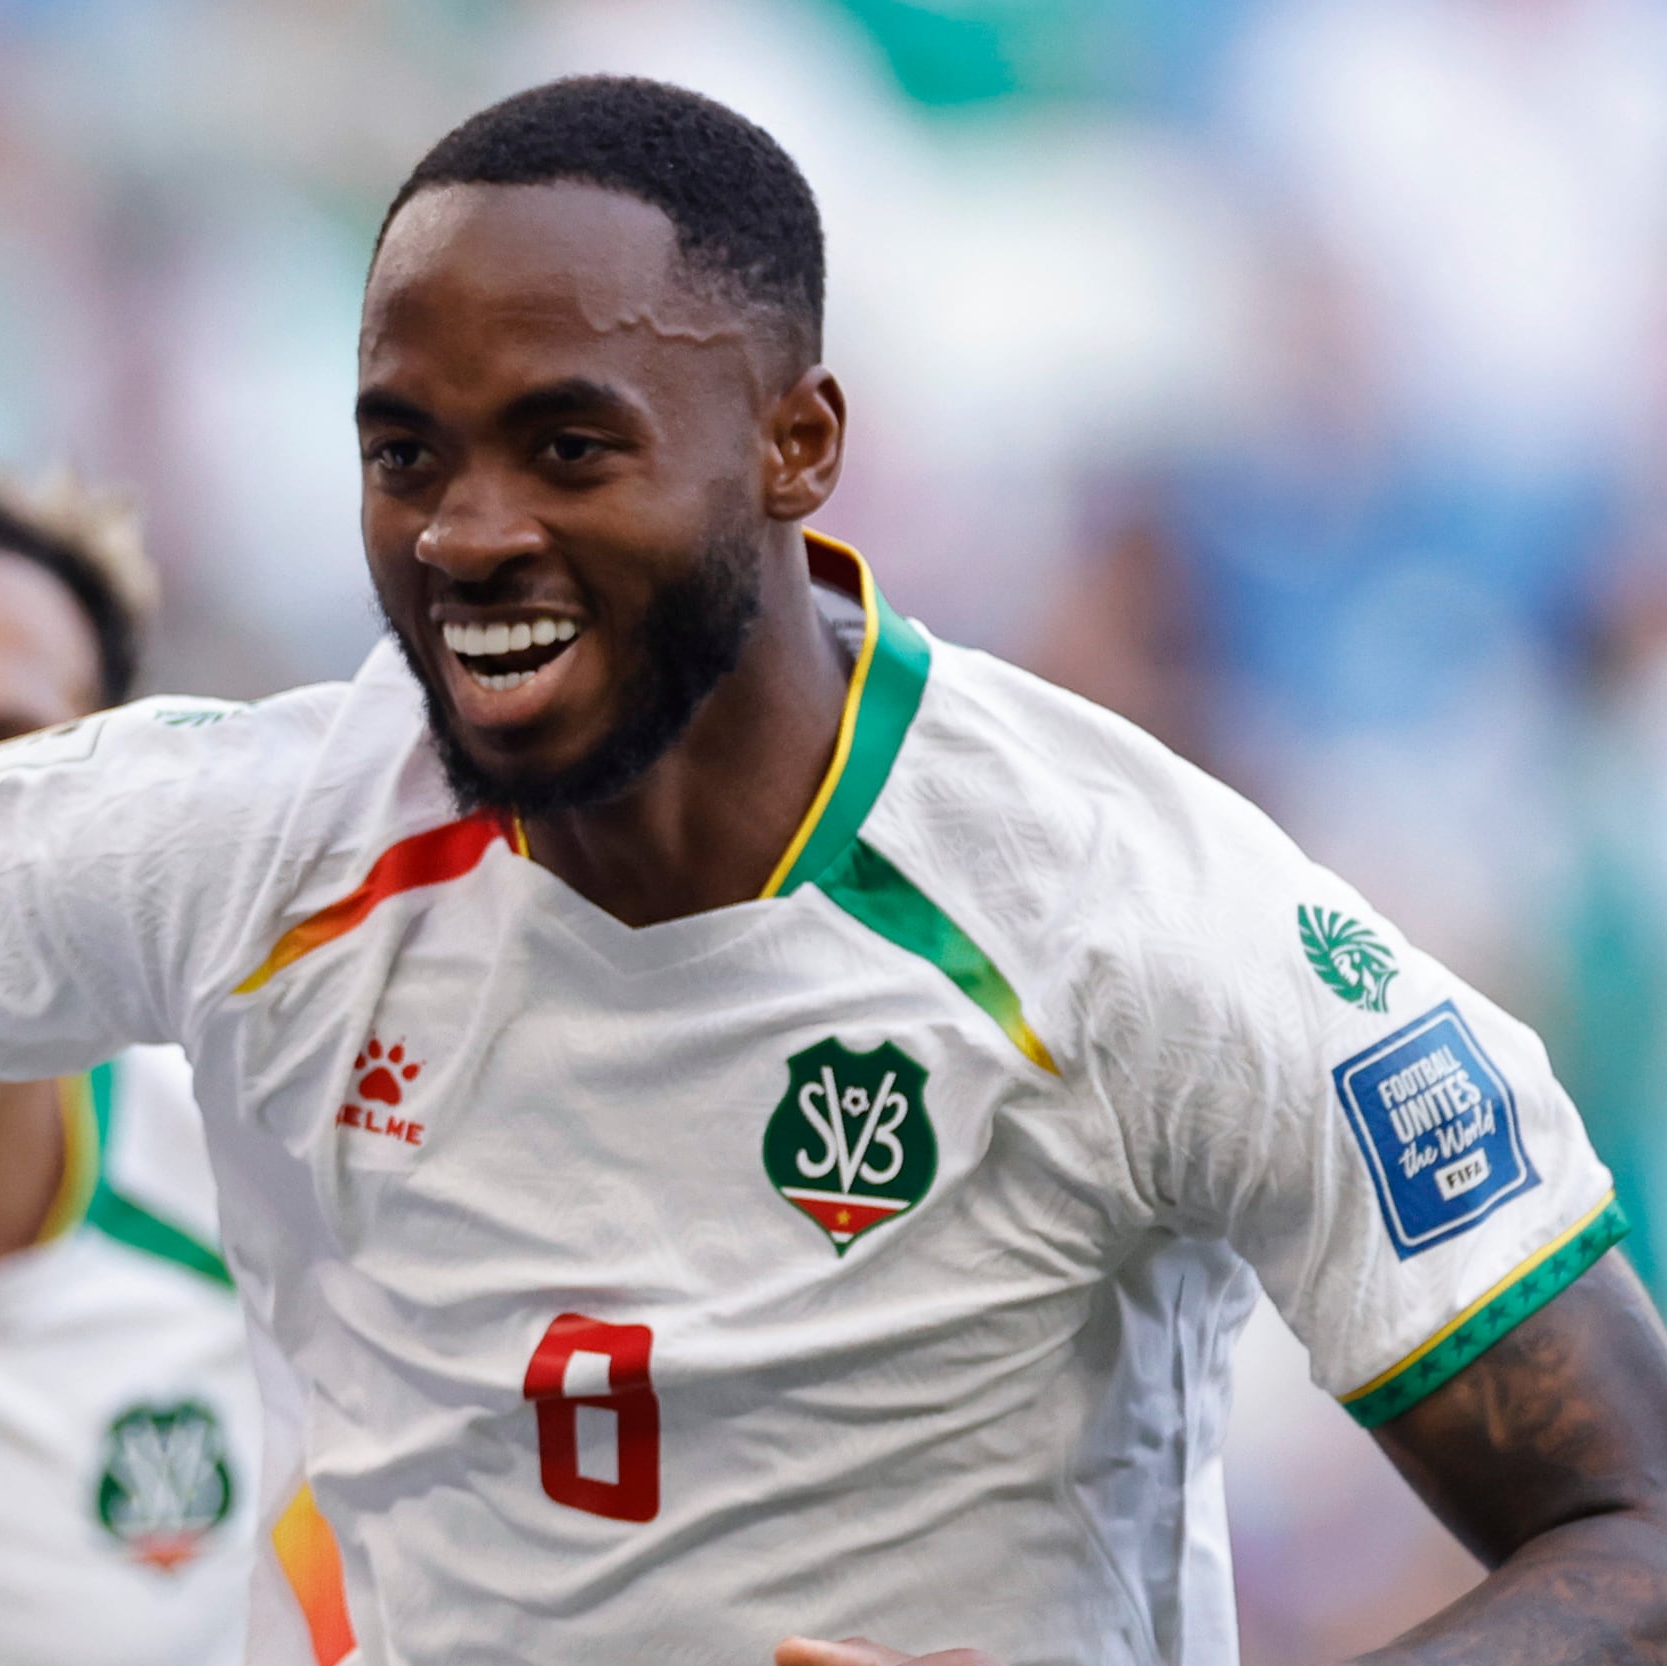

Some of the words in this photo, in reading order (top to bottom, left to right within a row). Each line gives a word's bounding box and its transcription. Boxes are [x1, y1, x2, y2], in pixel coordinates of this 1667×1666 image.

[1378, 1044, 1463, 1108] FOOTBALL
[1389, 1069, 1482, 1144] UNITES
[1399, 1142, 1438, 1179] the
[1435, 1099, 1496, 1159] World
[1445, 1160, 1483, 1190] FIFA
[523, 1313, 660, 1524] 8
